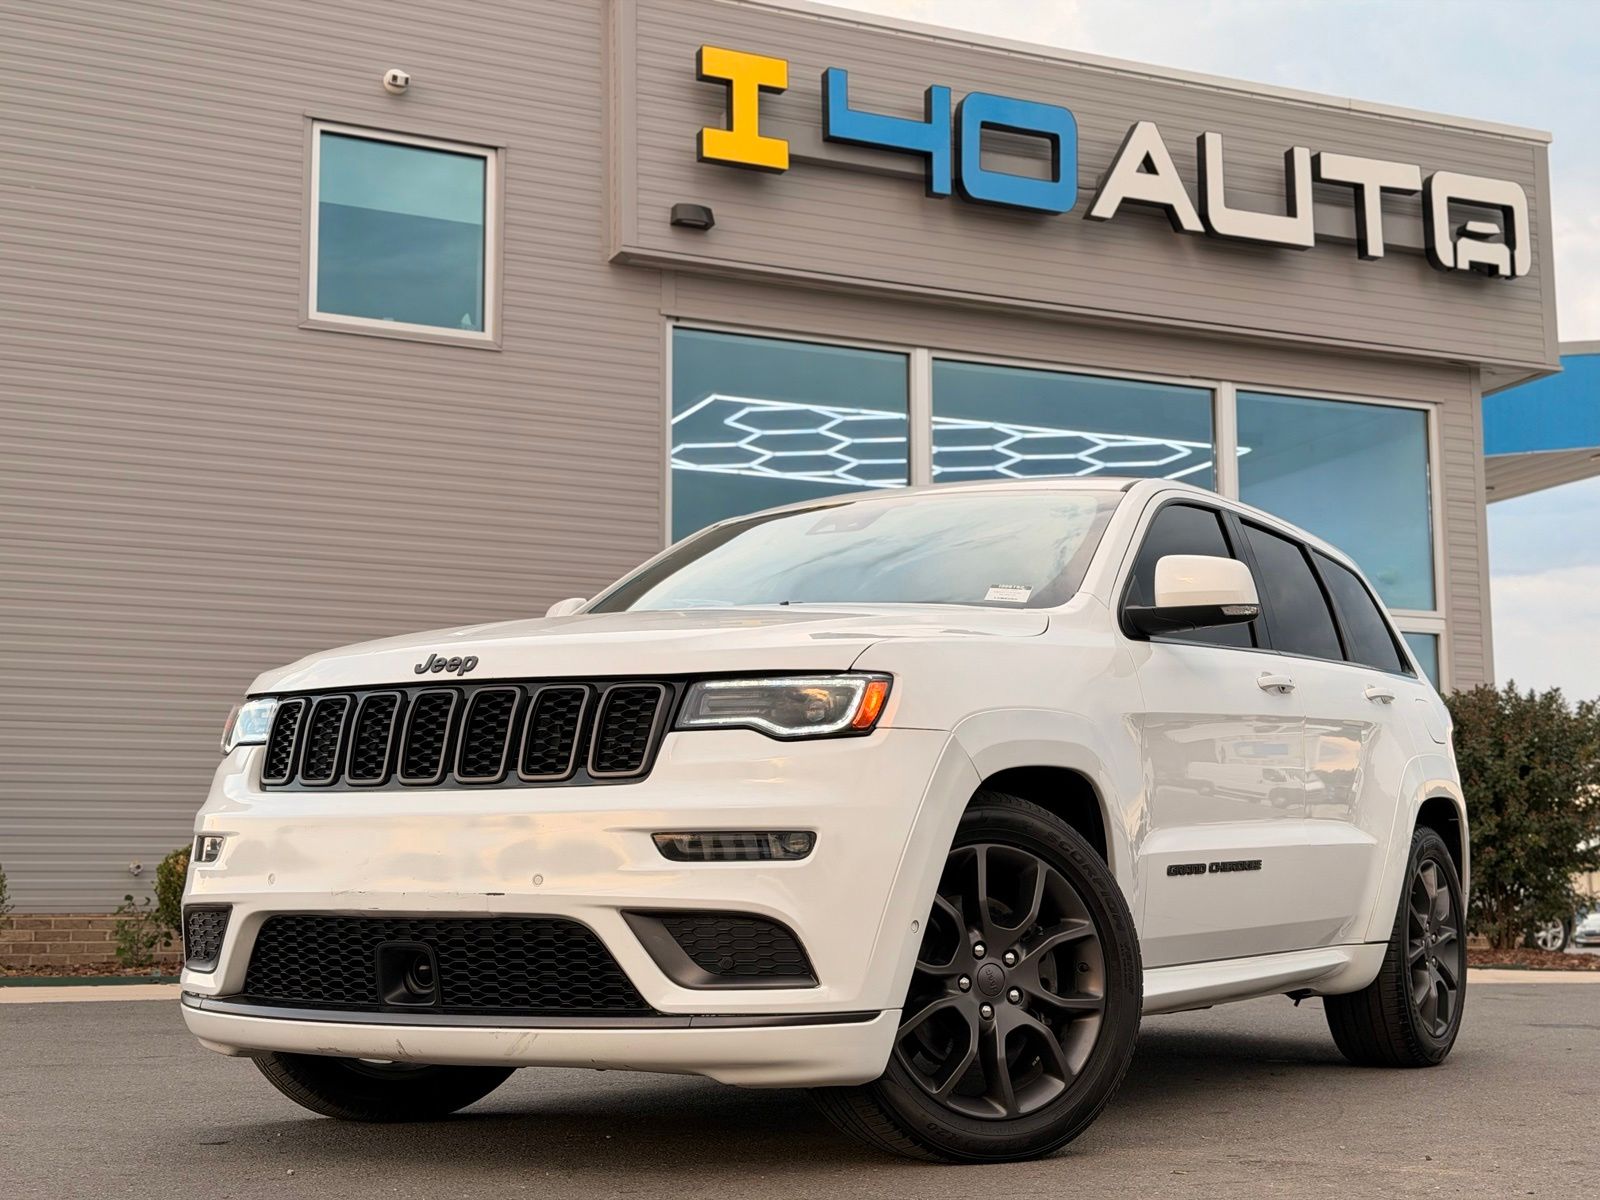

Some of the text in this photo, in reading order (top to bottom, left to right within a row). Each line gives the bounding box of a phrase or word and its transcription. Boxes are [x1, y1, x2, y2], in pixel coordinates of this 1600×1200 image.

[1083, 120, 1531, 279] AUTO
[414, 653, 479, 677] Jeep
[1166, 863, 1206, 876] GRAND
